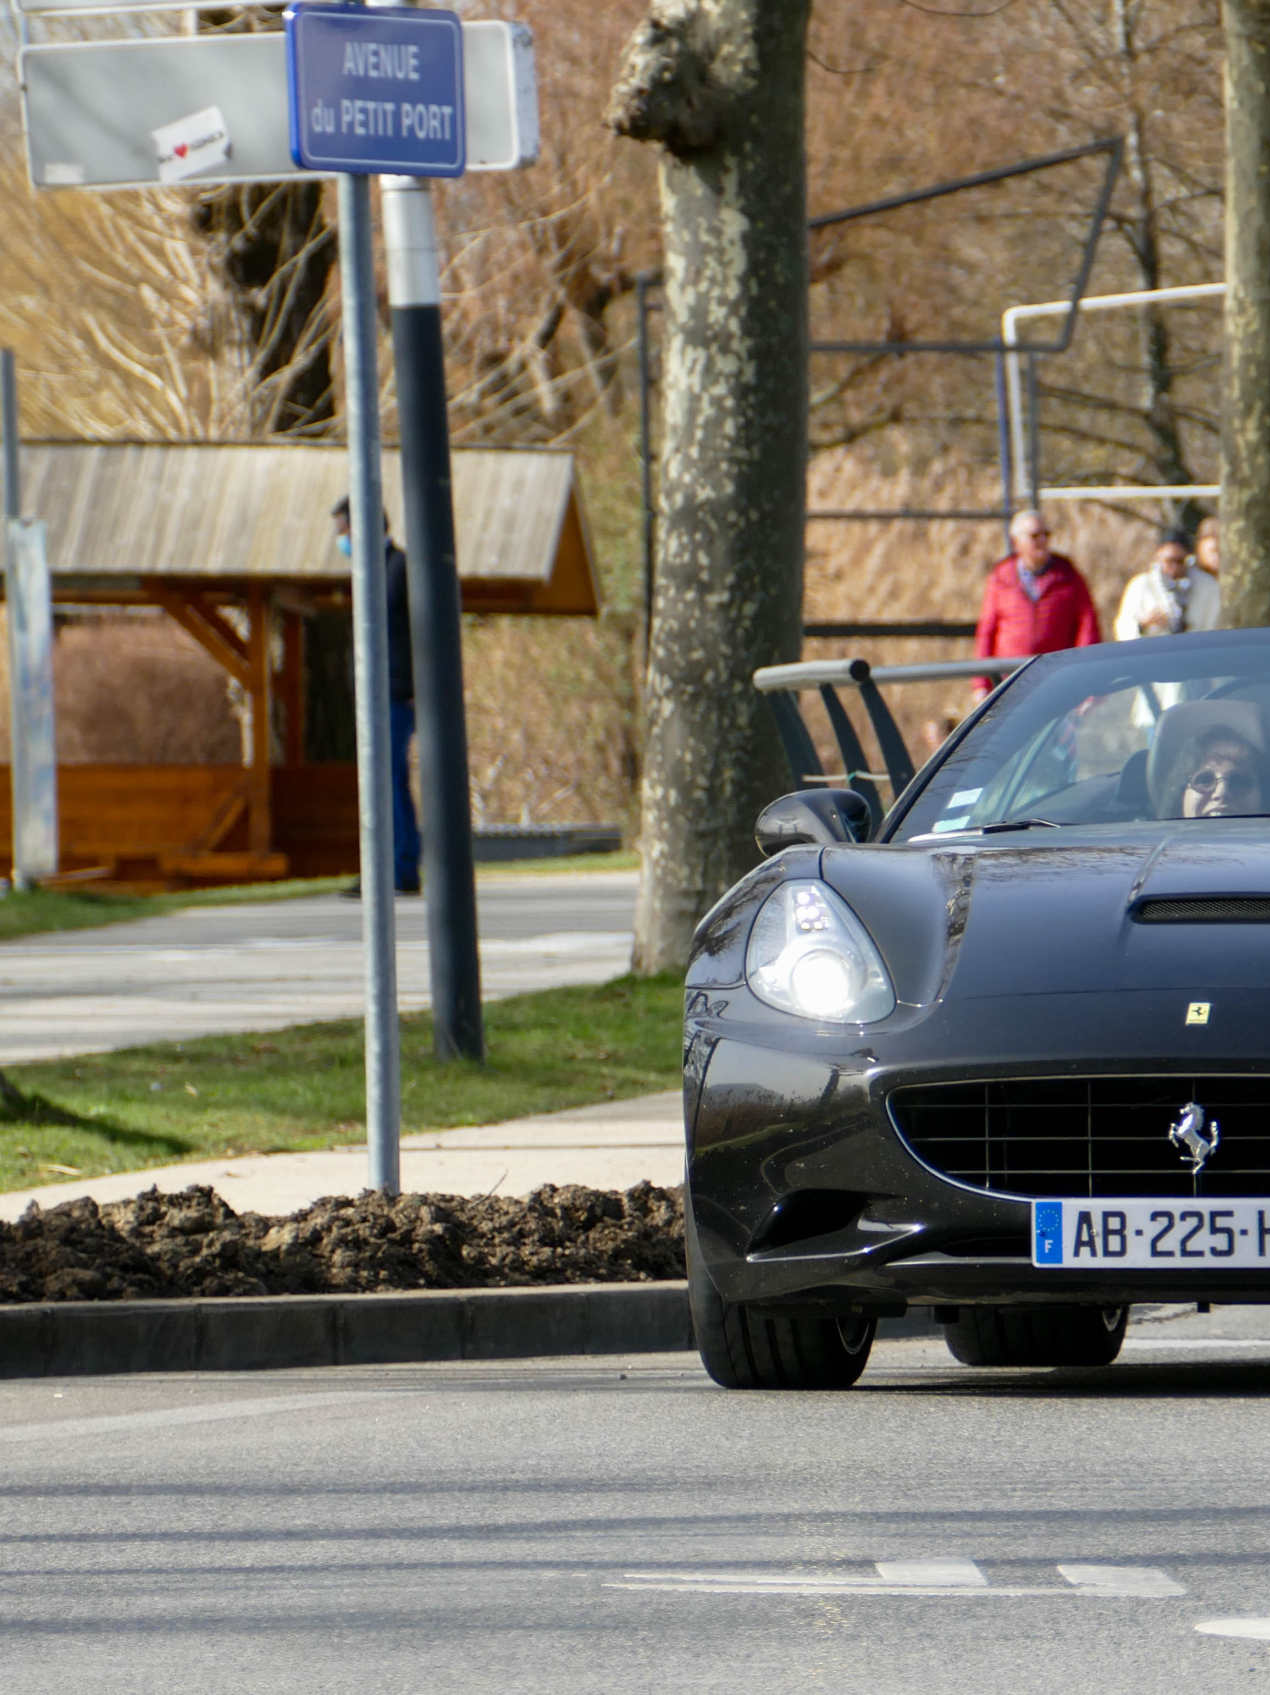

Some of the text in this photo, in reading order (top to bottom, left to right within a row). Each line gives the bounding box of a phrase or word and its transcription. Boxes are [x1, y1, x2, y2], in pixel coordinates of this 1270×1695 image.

[342, 42, 420, 81] AVENUE
[311, 100, 452, 140] du PETIT PORT
[1044, 1240, 1053, 1253] F
